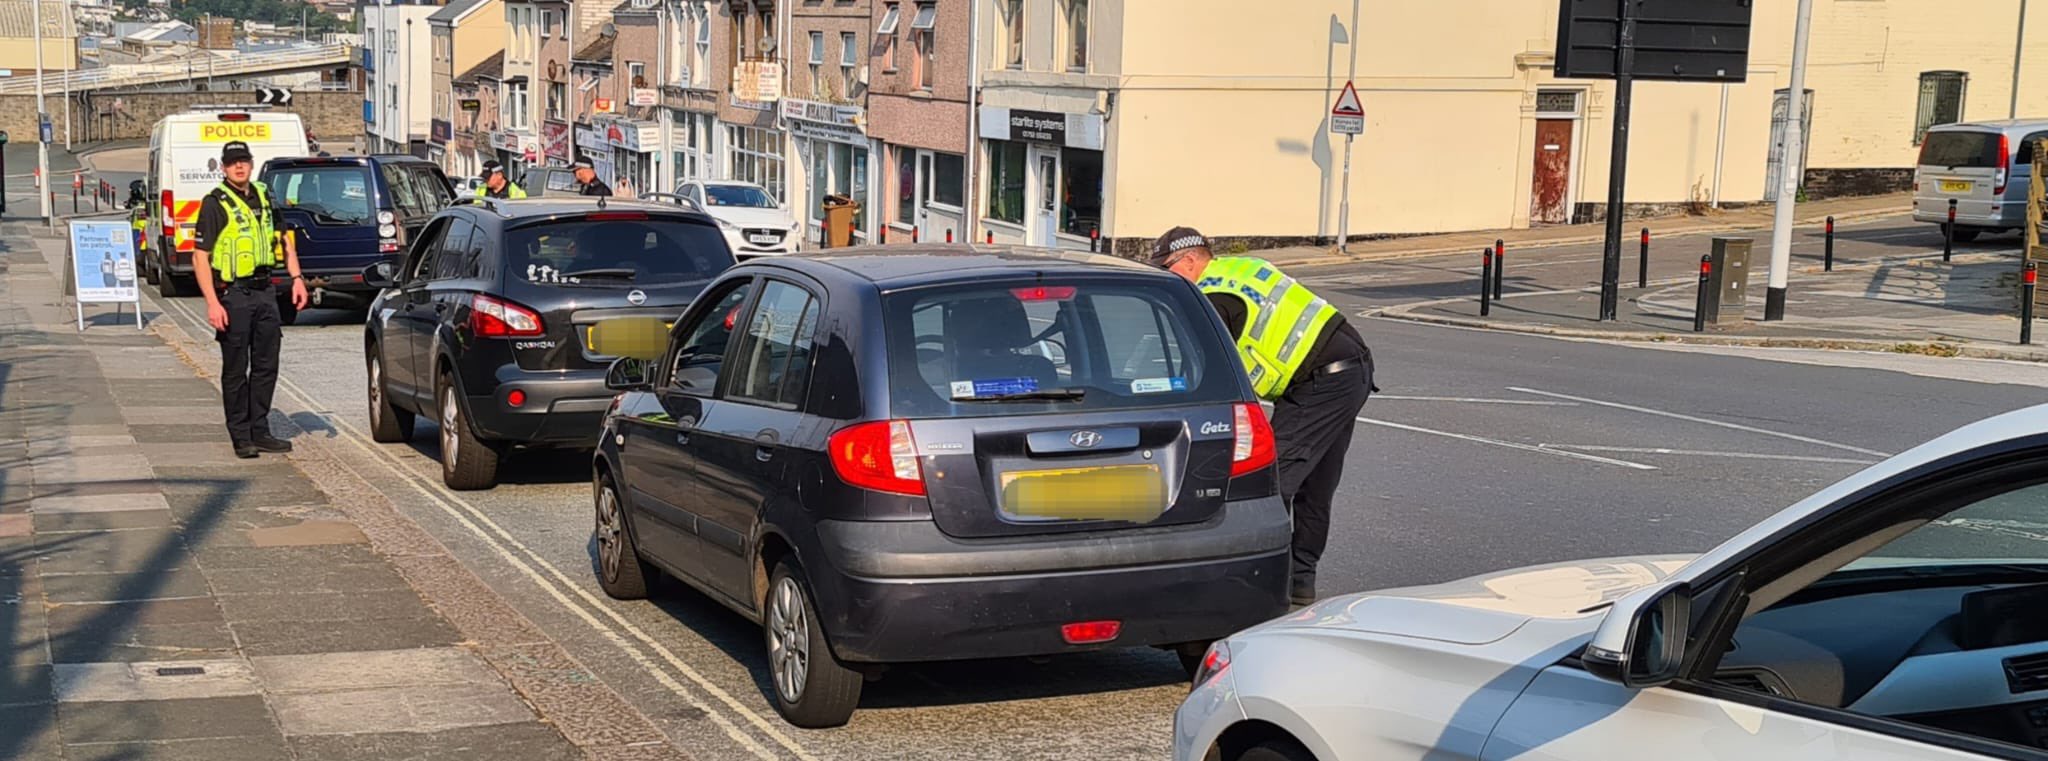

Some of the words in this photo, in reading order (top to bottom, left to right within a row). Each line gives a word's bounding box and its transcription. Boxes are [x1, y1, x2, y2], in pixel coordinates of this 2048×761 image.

[1011, 116, 1034, 128] starlite
[1034, 119, 1065, 131] systems
[204, 124, 266, 138] POLICE
[179, 172, 226, 181] SERVATO
[515, 341, 556, 350] QASHQAI
[1200, 421, 1231, 435] Getz
